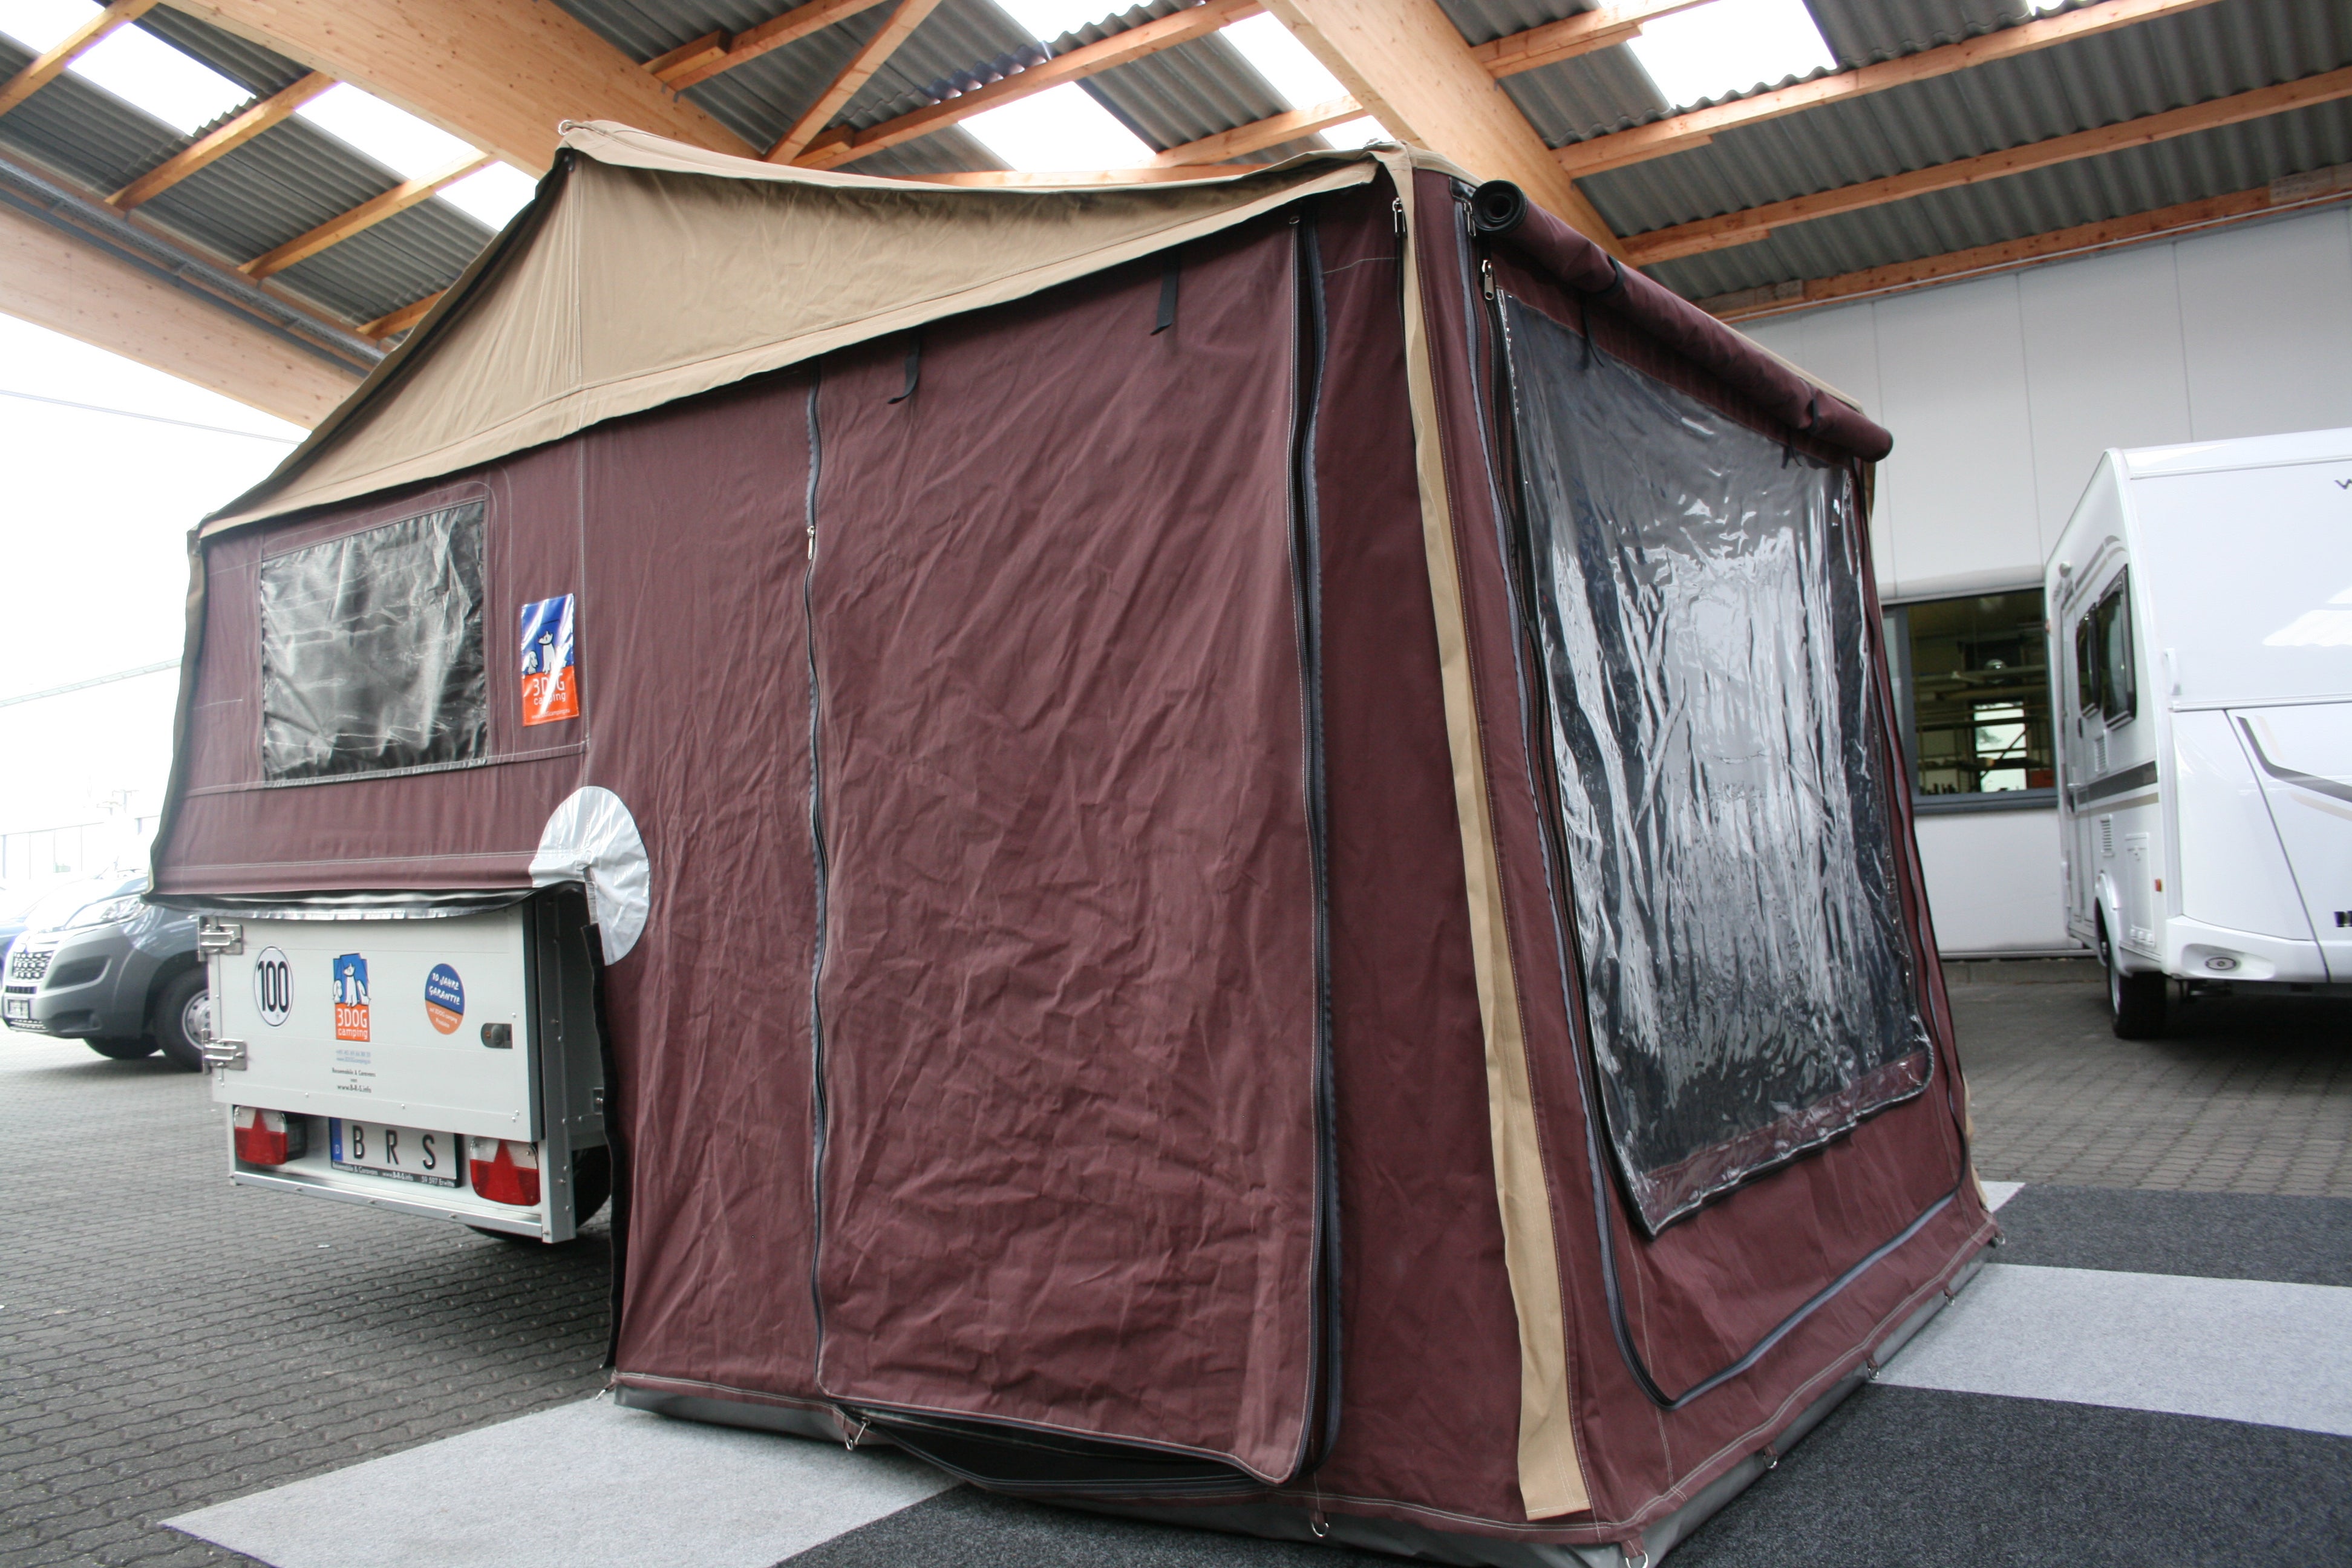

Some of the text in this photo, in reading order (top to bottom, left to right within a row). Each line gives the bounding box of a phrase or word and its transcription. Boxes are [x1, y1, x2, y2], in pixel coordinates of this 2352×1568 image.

[532, 672, 565, 696] 3DG
[534, 692, 566, 705] caing
[258, 961, 289, 1013] 100
[433, 973, 460, 990] 10 JAHRE
[428, 985, 460, 1005] GARANTIE
[338, 1008, 367, 1028] 3DOG
[338, 1028, 368, 1040] camping
[353, 1125, 436, 1169] B R S
